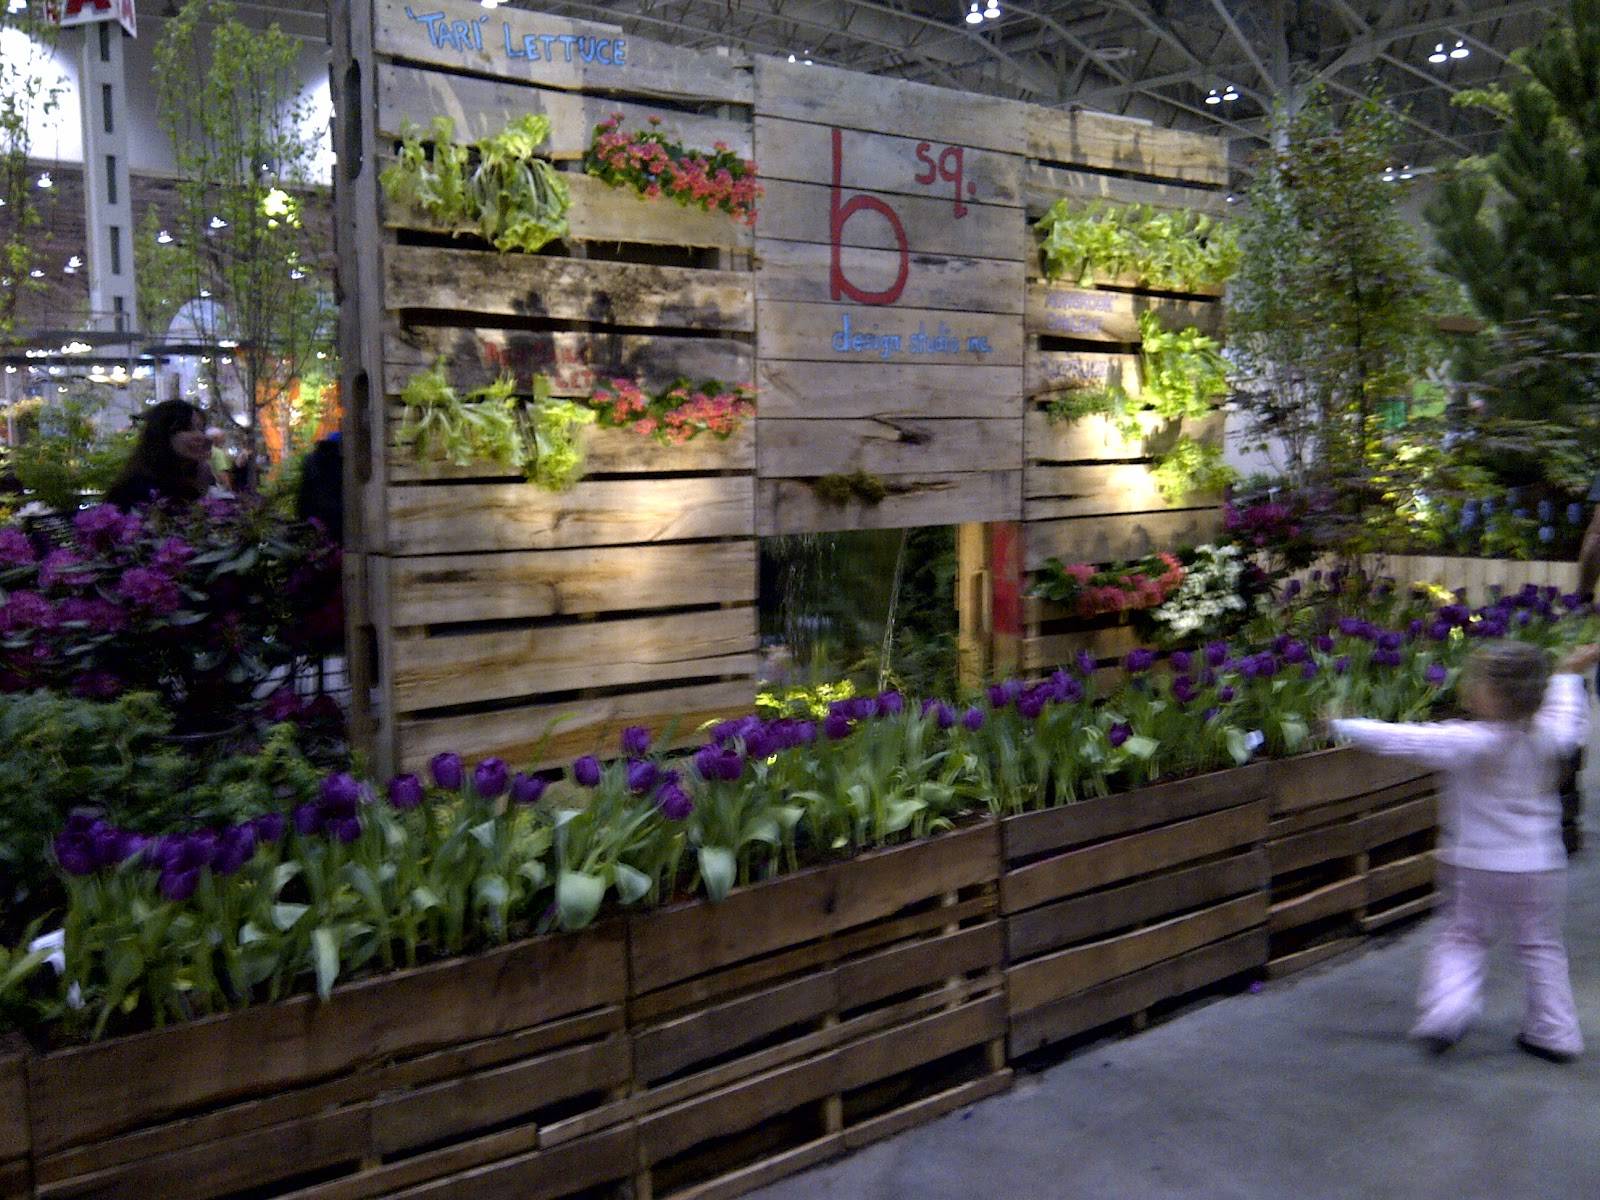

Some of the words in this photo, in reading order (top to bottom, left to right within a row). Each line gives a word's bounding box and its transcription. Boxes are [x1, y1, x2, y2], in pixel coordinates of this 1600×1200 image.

[503, 22, 625, 66] LETTUCE
[830, 127, 909, 306] b
[832, 312, 902, 360] design
